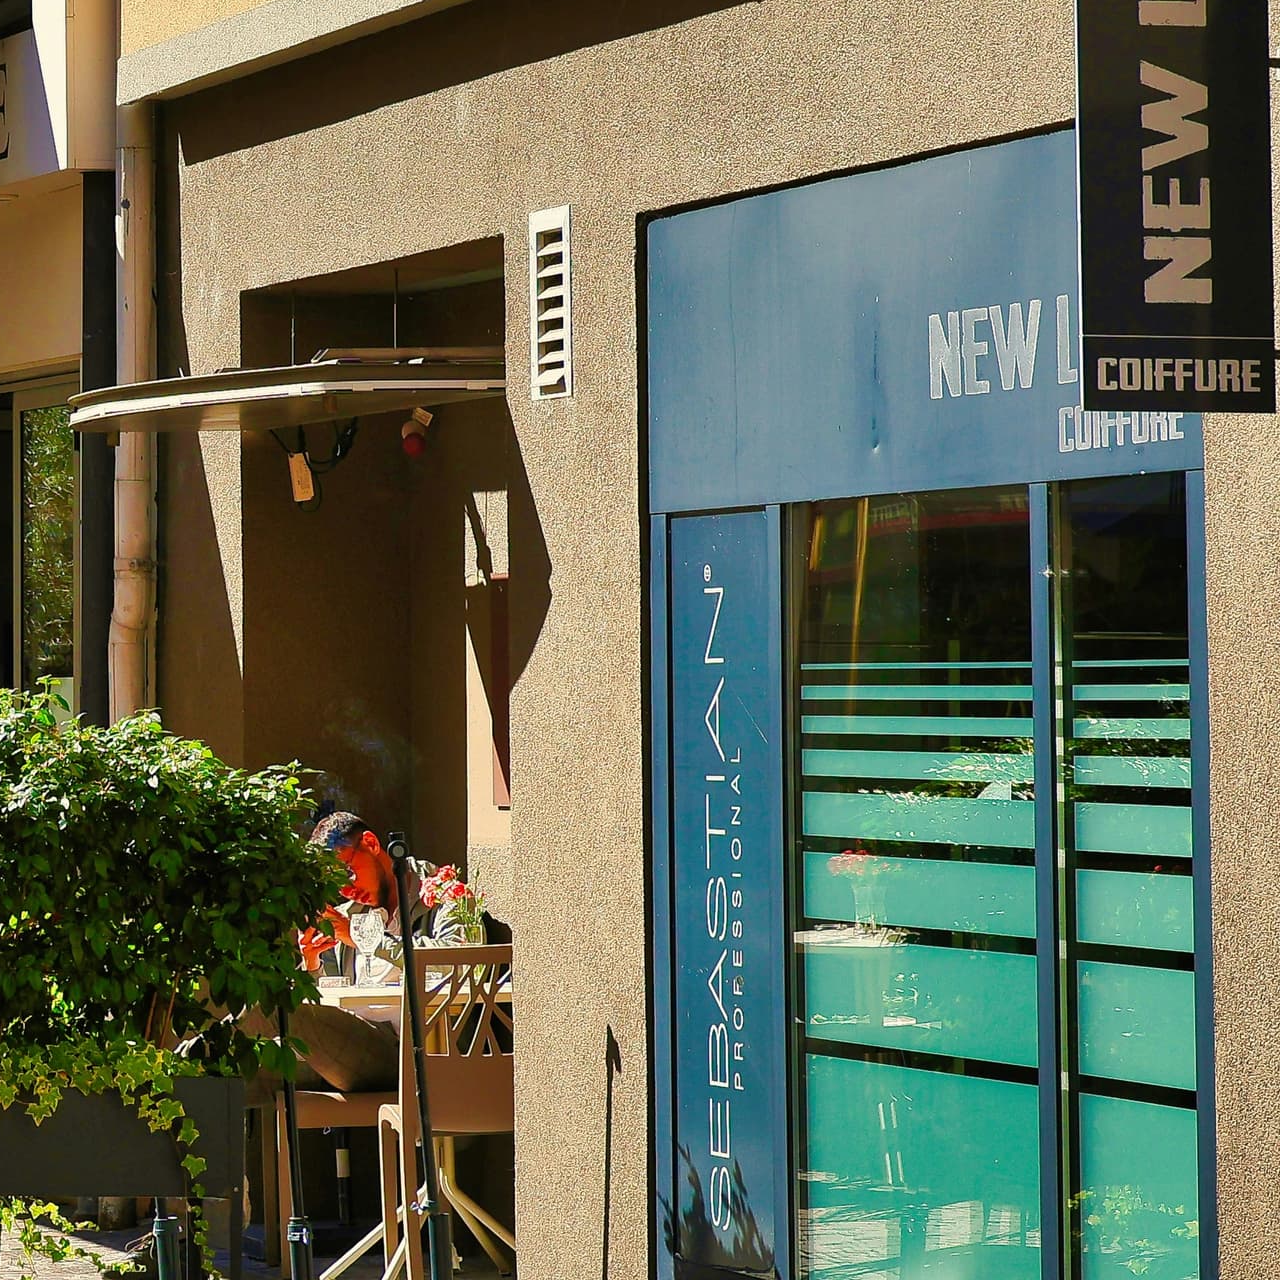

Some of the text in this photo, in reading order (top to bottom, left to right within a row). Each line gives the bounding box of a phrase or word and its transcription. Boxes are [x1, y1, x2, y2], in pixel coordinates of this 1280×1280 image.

[1140, 59, 1213, 304] NEW
[928, 299, 1042, 400] NEW
[1097, 356, 1262, 393] COIFFURE
[1058, 405, 1185, 453] COIFFURE
[730, 746, 745, 1091] PROFESSIONAL
